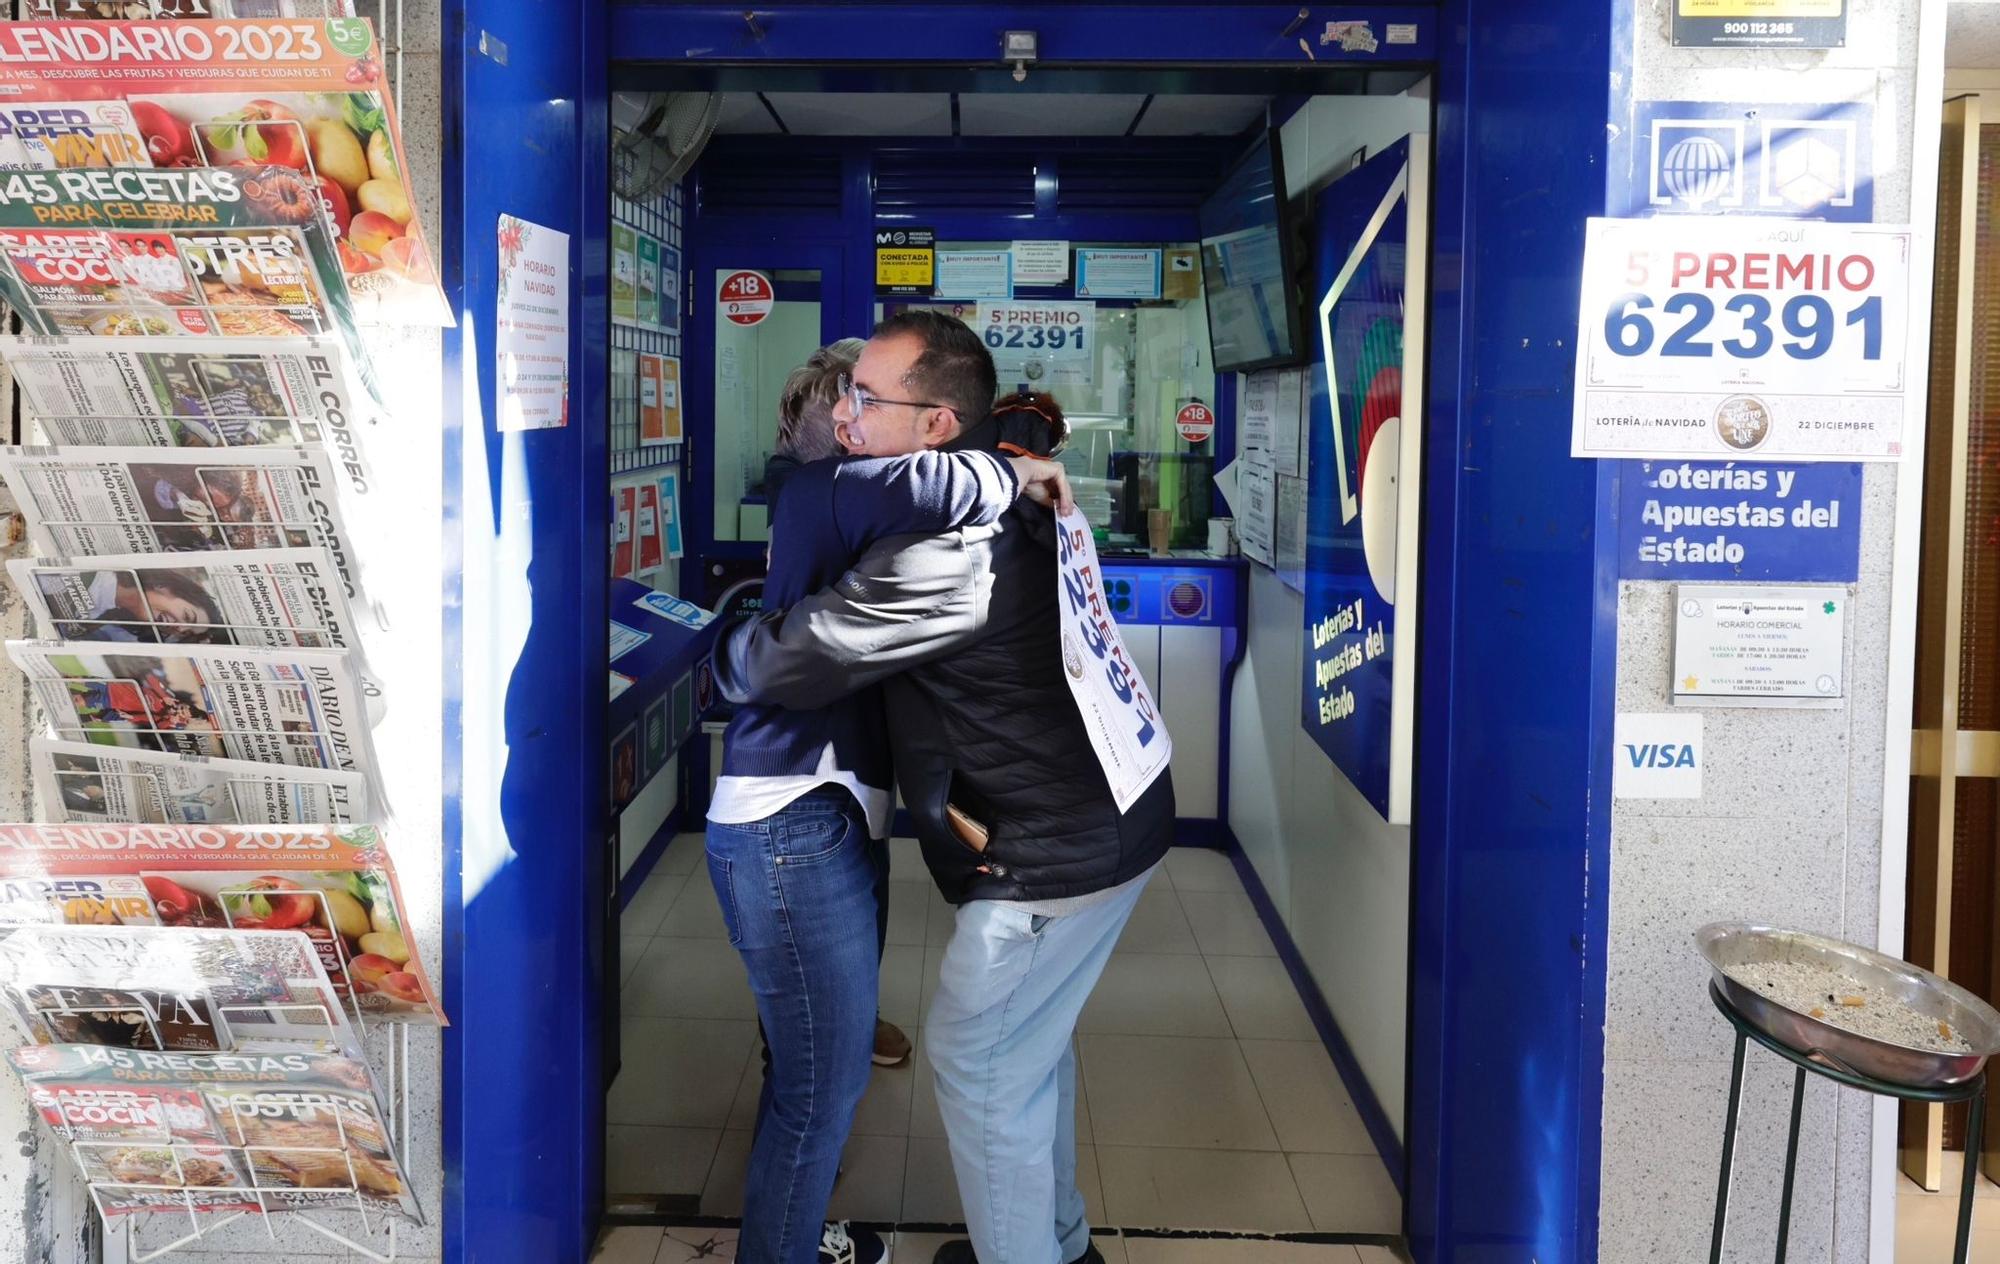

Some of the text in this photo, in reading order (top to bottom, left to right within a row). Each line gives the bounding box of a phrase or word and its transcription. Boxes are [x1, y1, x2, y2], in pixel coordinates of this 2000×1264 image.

[215, 24, 322, 61] 2023
[1724, 23, 1748, 33] 900
[1751, 23, 1768, 34] 112
[42, 69, 99, 79] DESCUBRE
[101, 69, 121, 78] LAS
[124, 68, 164, 78] FRUTAS
[166, 69, 174, 78] Y
[175, 68, 234, 78] VERDURAS
[236, 68, 260, 78] QUE
[261, 68, 301, 77] CUIDAN
[304, 68, 320, 77] DE
[320, 68, 332, 77] TI
[37, 134, 146, 164] VIVIR
[57, 171, 241, 203] RECETAS
[32, 202, 219, 223] PARA CELEBRAR
[0, 234, 112, 260] SABER
[524, 260, 555, 277] HORARIO
[1671, 252, 1875, 292] PREMIO
[524, 280, 555, 296] NAVIDAD
[729, 277, 759, 295] +18
[1008, 311, 1080, 325] PREMIO
[1604, 292, 1882, 361] 62391
[985, 325, 1083, 349] 62391
[118, 352, 129, 367] Los
[124, 368, 149, 405] parques
[144, 406, 162, 434] eóicos
[306, 356, 368, 495] EL CORREO
[1184, 408, 1205, 420] +18
[1596, 416, 1640, 427] LOTERÍA
[1655, 418, 1706, 429] NAVIDAD
[1798, 421, 1811, 430] 22
[1814, 421, 1875, 432] DICIEMBRE
[296, 466, 320, 495] EL
[1776, 470, 1796, 497] y
[109, 491, 126, 517] euros
[129, 541, 140, 553] los
[112, 475, 150, 545] patronal aepta
[1642, 500, 1839, 532] Apuestas del
[1639, 536, 1744, 564] Estado
[295, 562, 319, 584] EL
[62, 576, 89, 620] LA ALEGRÍA
[72, 576, 94, 610] REGRESA
[1057, 521, 1156, 749] 62391
[1312, 598, 1363, 650] Loterías y
[1717, 621, 1802, 630] HORARIO COMERCIAL
[1080, 565, 1154, 721] PREMIO
[1315, 621, 1385, 692] Apuestas del
[214, 659, 226, 670] en
[220, 671, 230, 679] la
[236, 717, 248, 728] de
[243, 693, 255, 702] al
[243, 661, 255, 670] El
[271, 741, 280, 750] la
[1319, 687, 1355, 725] Estado
[245, 704, 260, 731] dudar
[309, 666, 351, 755] DIARIO DE
[257, 744, 268, 753] la
[1622, 744, 1695, 768] VISA
[267, 803, 276, 813] de
[18, 984, 210, 1027] TEVA
[72, 1047, 135, 1069] 145
[138, 1053, 309, 1072] RECETAS
[112, 1068, 288, 1082] PARA CELEBRAR
[31, 1090, 142, 1108] SABER
[205, 1093, 373, 1123] POSTRES
[65, 1106, 180, 1125] COCIN
